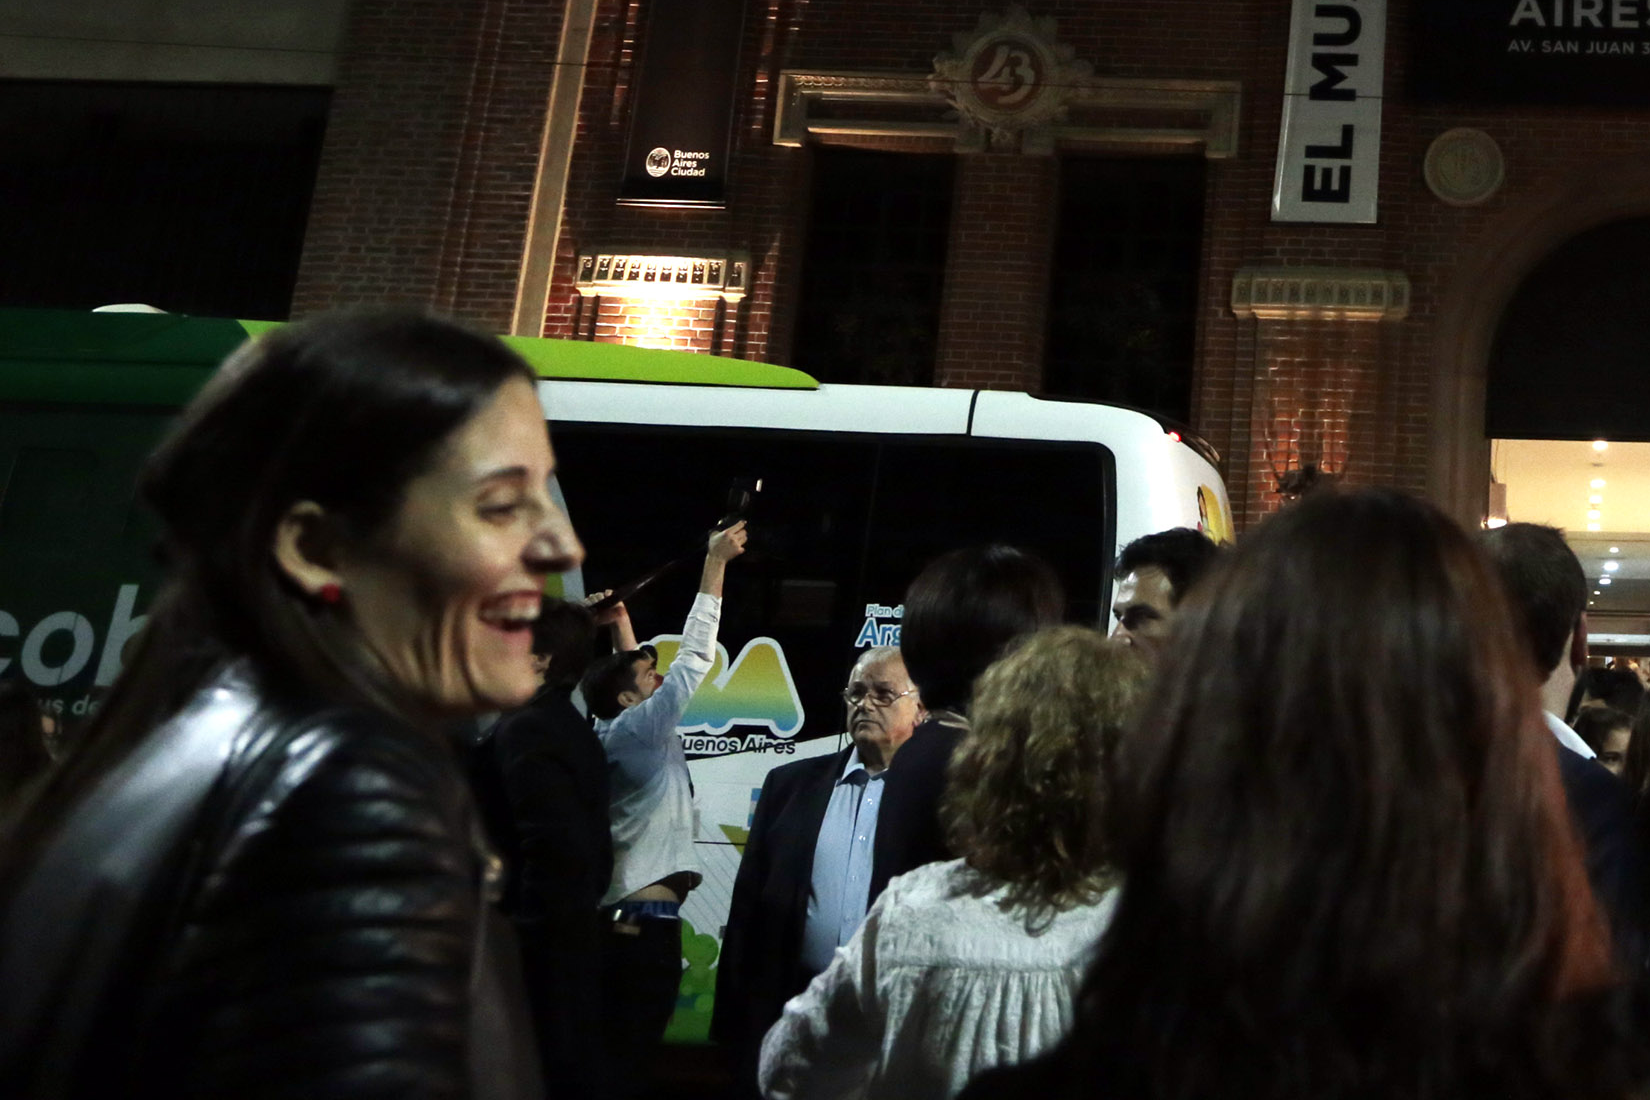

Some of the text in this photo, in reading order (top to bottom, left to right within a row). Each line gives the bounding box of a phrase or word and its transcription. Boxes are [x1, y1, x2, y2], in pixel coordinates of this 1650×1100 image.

[1507, 38, 1536, 53] AV.
[1541, 39, 1579, 55] SAN
[1585, 40, 1635, 55] JUAN
[673, 149, 710, 160] Buenos
[671, 158, 698, 168] Aires
[1302, 124, 1354, 203] EL
[670, 167, 706, 177] Ciudad
[867, 604, 891, 616] Plan
[678, 736, 796, 755] uenos Aires
